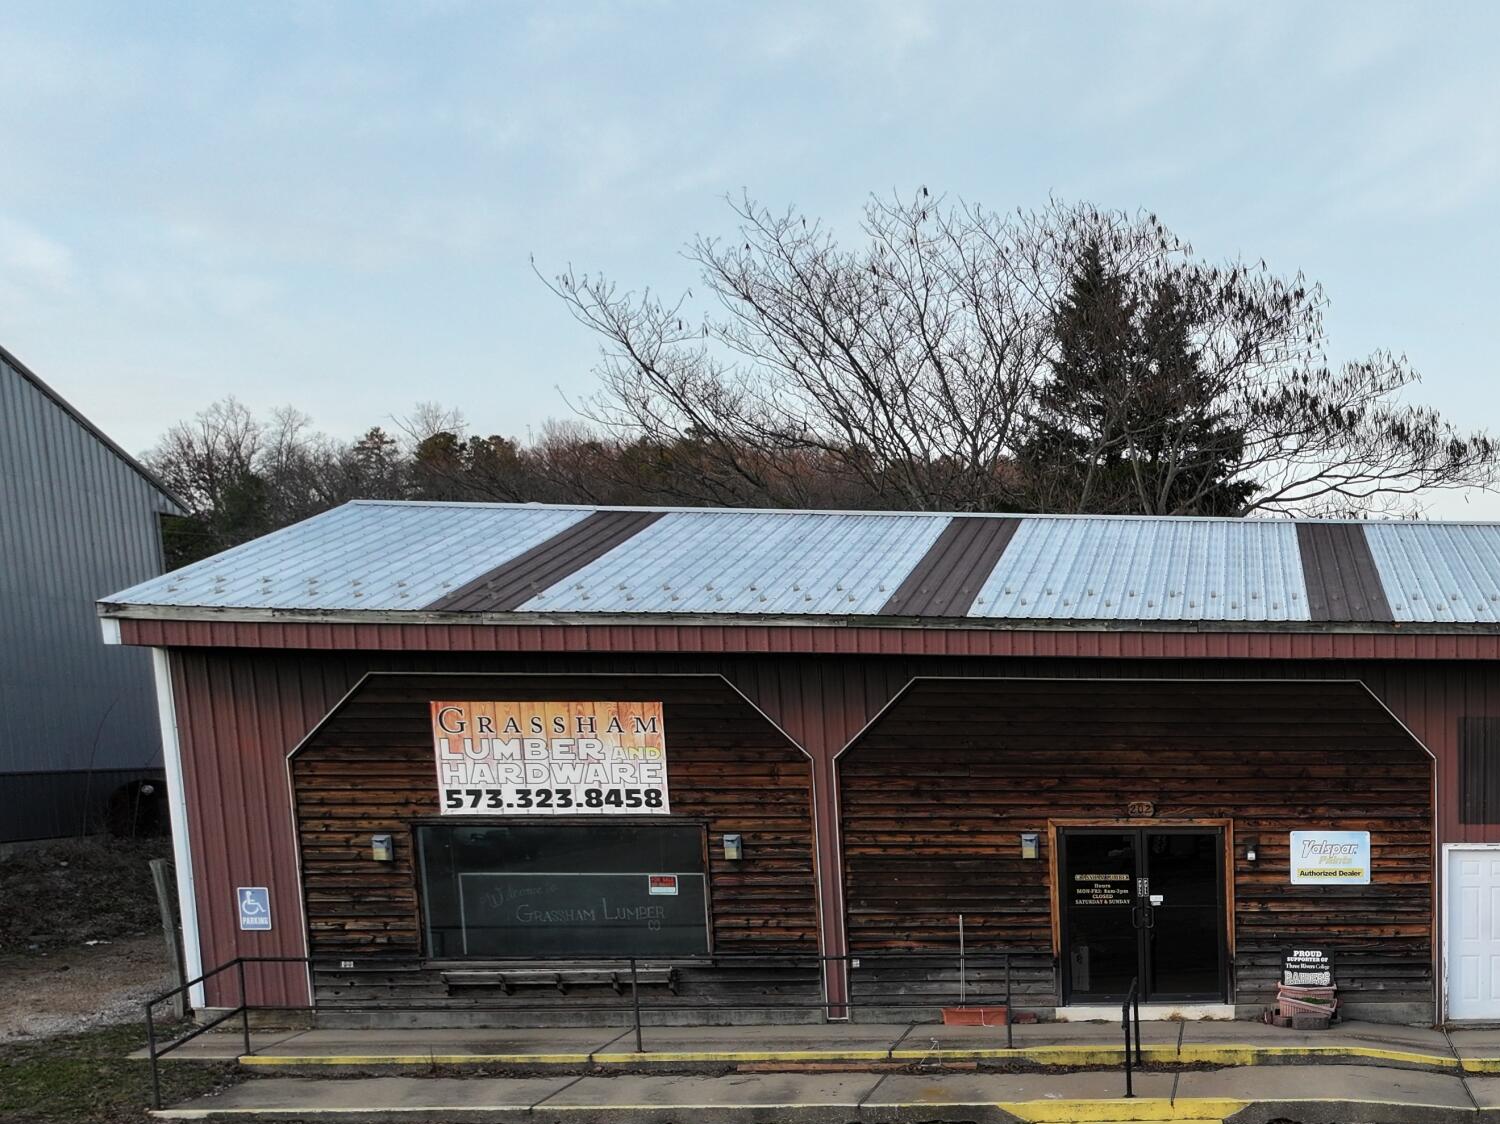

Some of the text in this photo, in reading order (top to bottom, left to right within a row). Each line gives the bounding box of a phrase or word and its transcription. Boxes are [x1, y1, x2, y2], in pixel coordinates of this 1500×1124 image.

[438, 707, 658, 734] GRASSHAM
[439, 738, 661, 761] LUMBER AND
[442, 763, 663, 785] HARDWARE
[445, 788, 663, 809] 573.323.8458
[1130, 805, 1151, 814] 202
[516, 898, 665, 923] GRASSHAM LUMBER
